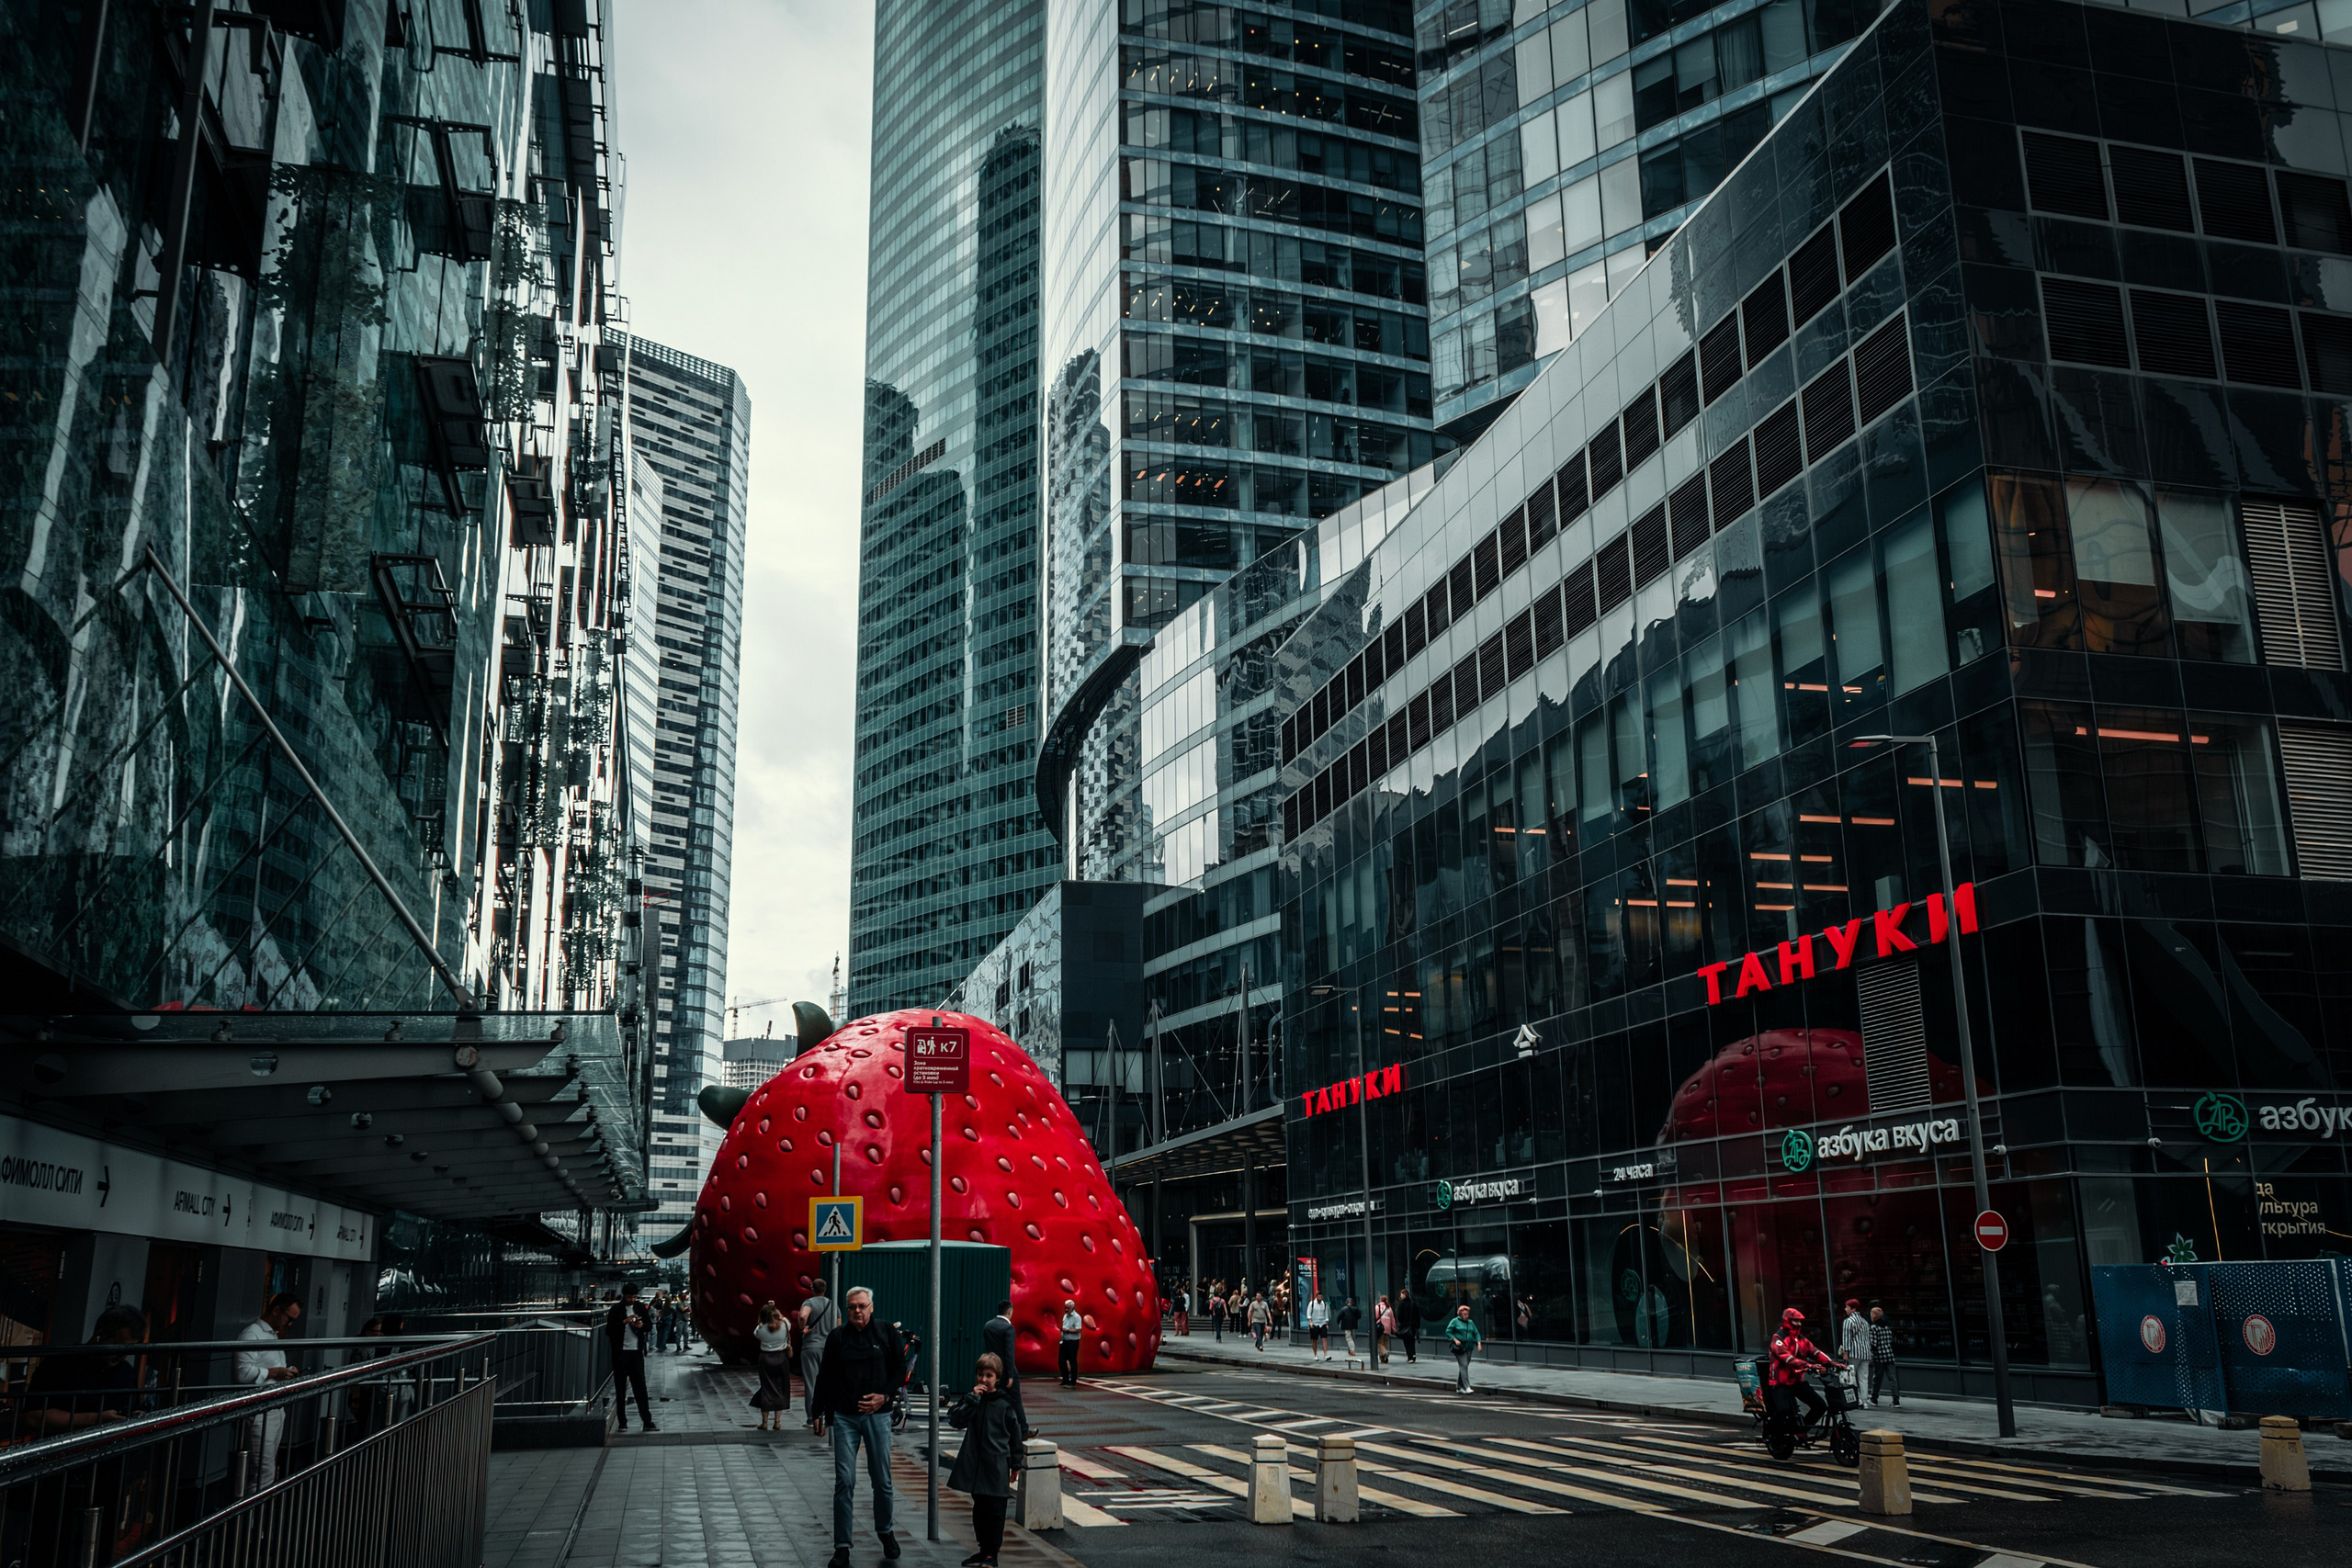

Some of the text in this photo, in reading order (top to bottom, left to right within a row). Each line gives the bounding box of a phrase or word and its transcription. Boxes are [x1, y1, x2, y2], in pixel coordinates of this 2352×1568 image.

[1697, 882, 1979, 1006] ТАНУКИ
[1302, 1063, 1401, 1118] ТАНУКИ
[1818, 1125, 1890, 1161] азбука
[1893, 1119, 1961, 1153] вкуса
[0, 1156, 83, 1194] ФИМОЛЛ СИТИ
[1453, 1179, 1487, 1205] азбука
[1488, 1179, 1520, 1202] вкуса
[1613, 1163, 1654, 1181] 24 часа
